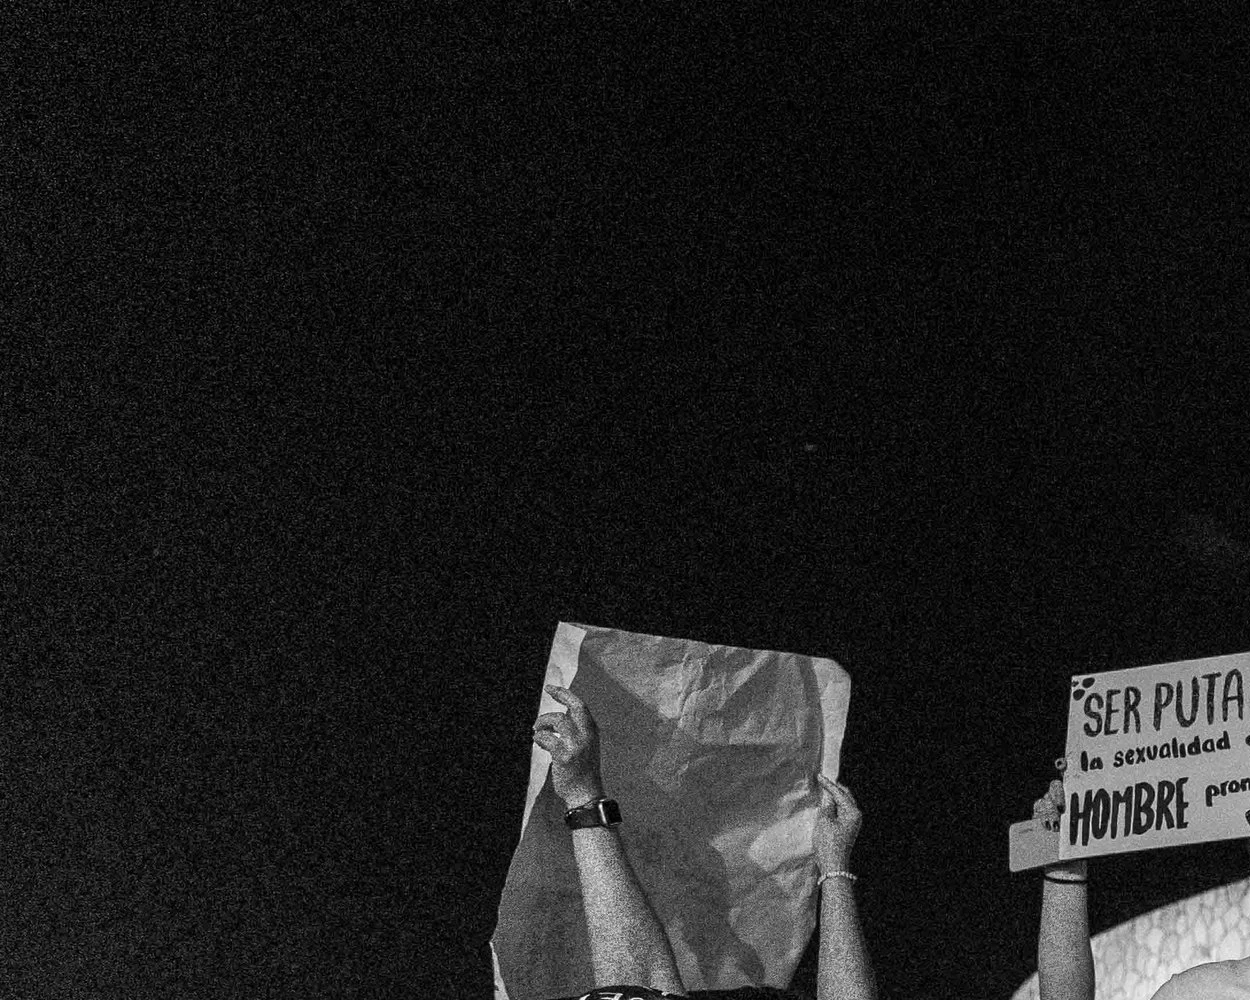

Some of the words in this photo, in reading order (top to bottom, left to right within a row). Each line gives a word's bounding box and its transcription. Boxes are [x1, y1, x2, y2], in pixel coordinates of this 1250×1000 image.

[1083, 686, 1142, 738] SER
[1152, 668, 1245, 732] PUTA
[1080, 750, 1104, 772] la
[1113, 731, 1231, 769] sexualidad
[1069, 777, 1189, 847] HOMBRE
